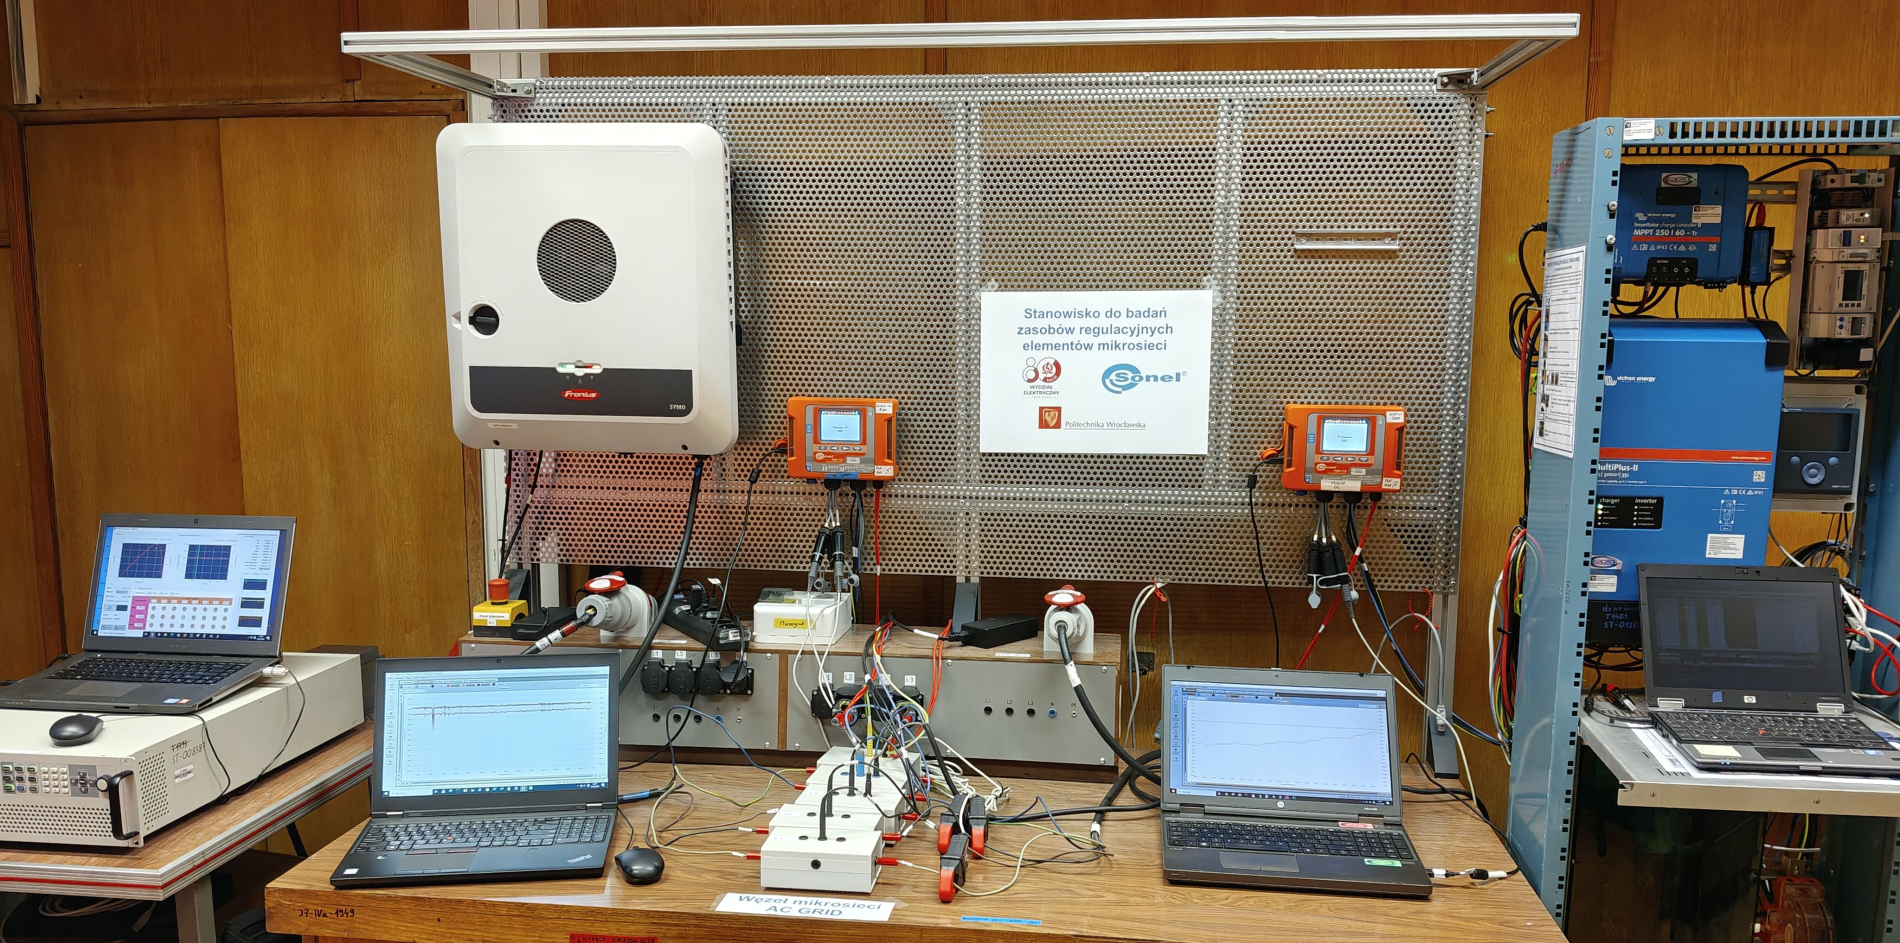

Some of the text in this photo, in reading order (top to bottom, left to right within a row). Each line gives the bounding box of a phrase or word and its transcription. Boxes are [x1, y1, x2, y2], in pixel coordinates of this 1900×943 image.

[1024, 307, 1167, 319] Stanowisko do badań
[1017, 324, 1173, 337] zasobów regulacyjnych
[1023, 340, 1167, 351] elementów mikrosieci
[1114, 372, 1180, 383] Sonel
[738, 895, 882, 910] Węzeł mikrosieci
[798, 907, 842, 916] GRID
